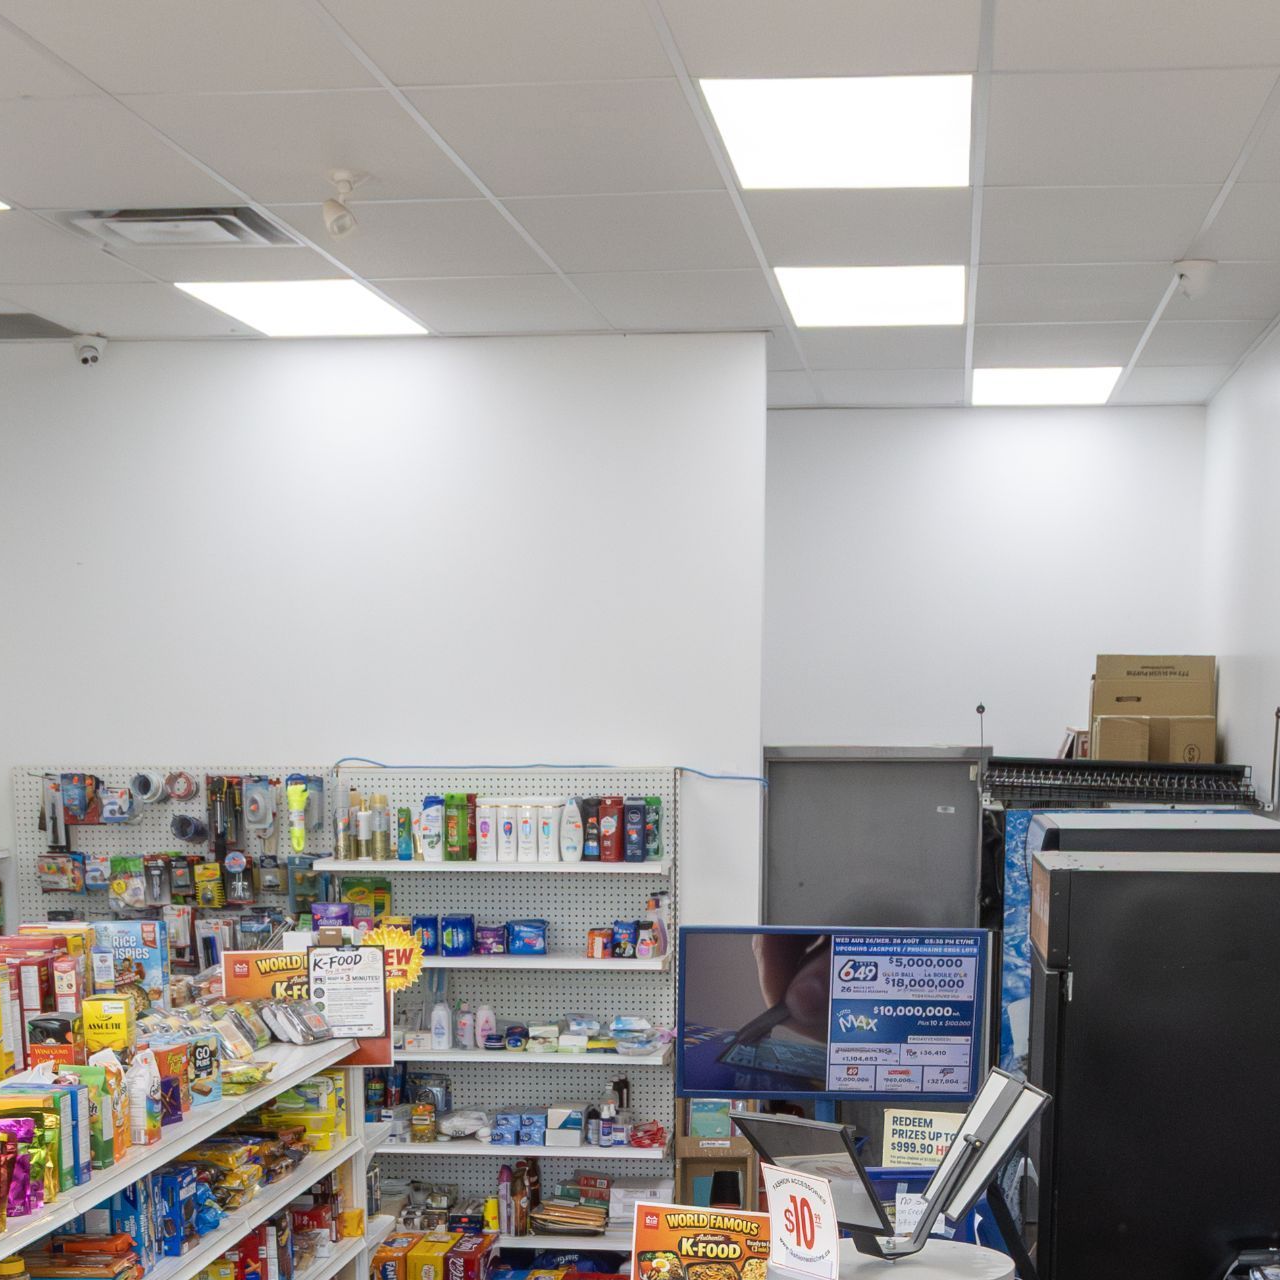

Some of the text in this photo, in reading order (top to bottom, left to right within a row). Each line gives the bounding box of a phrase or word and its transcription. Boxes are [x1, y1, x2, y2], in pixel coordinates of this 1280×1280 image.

[257, 954, 301, 973] WORLD
[313, 953, 363, 972] K-FOOD
[888, 956, 963, 968] $5,000,000
[885, 977, 965, 991] $18,000,000
[873, 1006, 953, 1017] $10,000,000
[195, 1047, 210, 1058] GO
[892, 1115, 933, 1128] REDEEM
[892, 1128, 942, 1141] PRIZES UP
[891, 1141, 934, 1155] $999.90
[666, 1214, 759, 1236] WORLD FAMOUS
[784, 1195, 816, 1250] $10
[681, 1238, 741, 1259] K-FOOD
